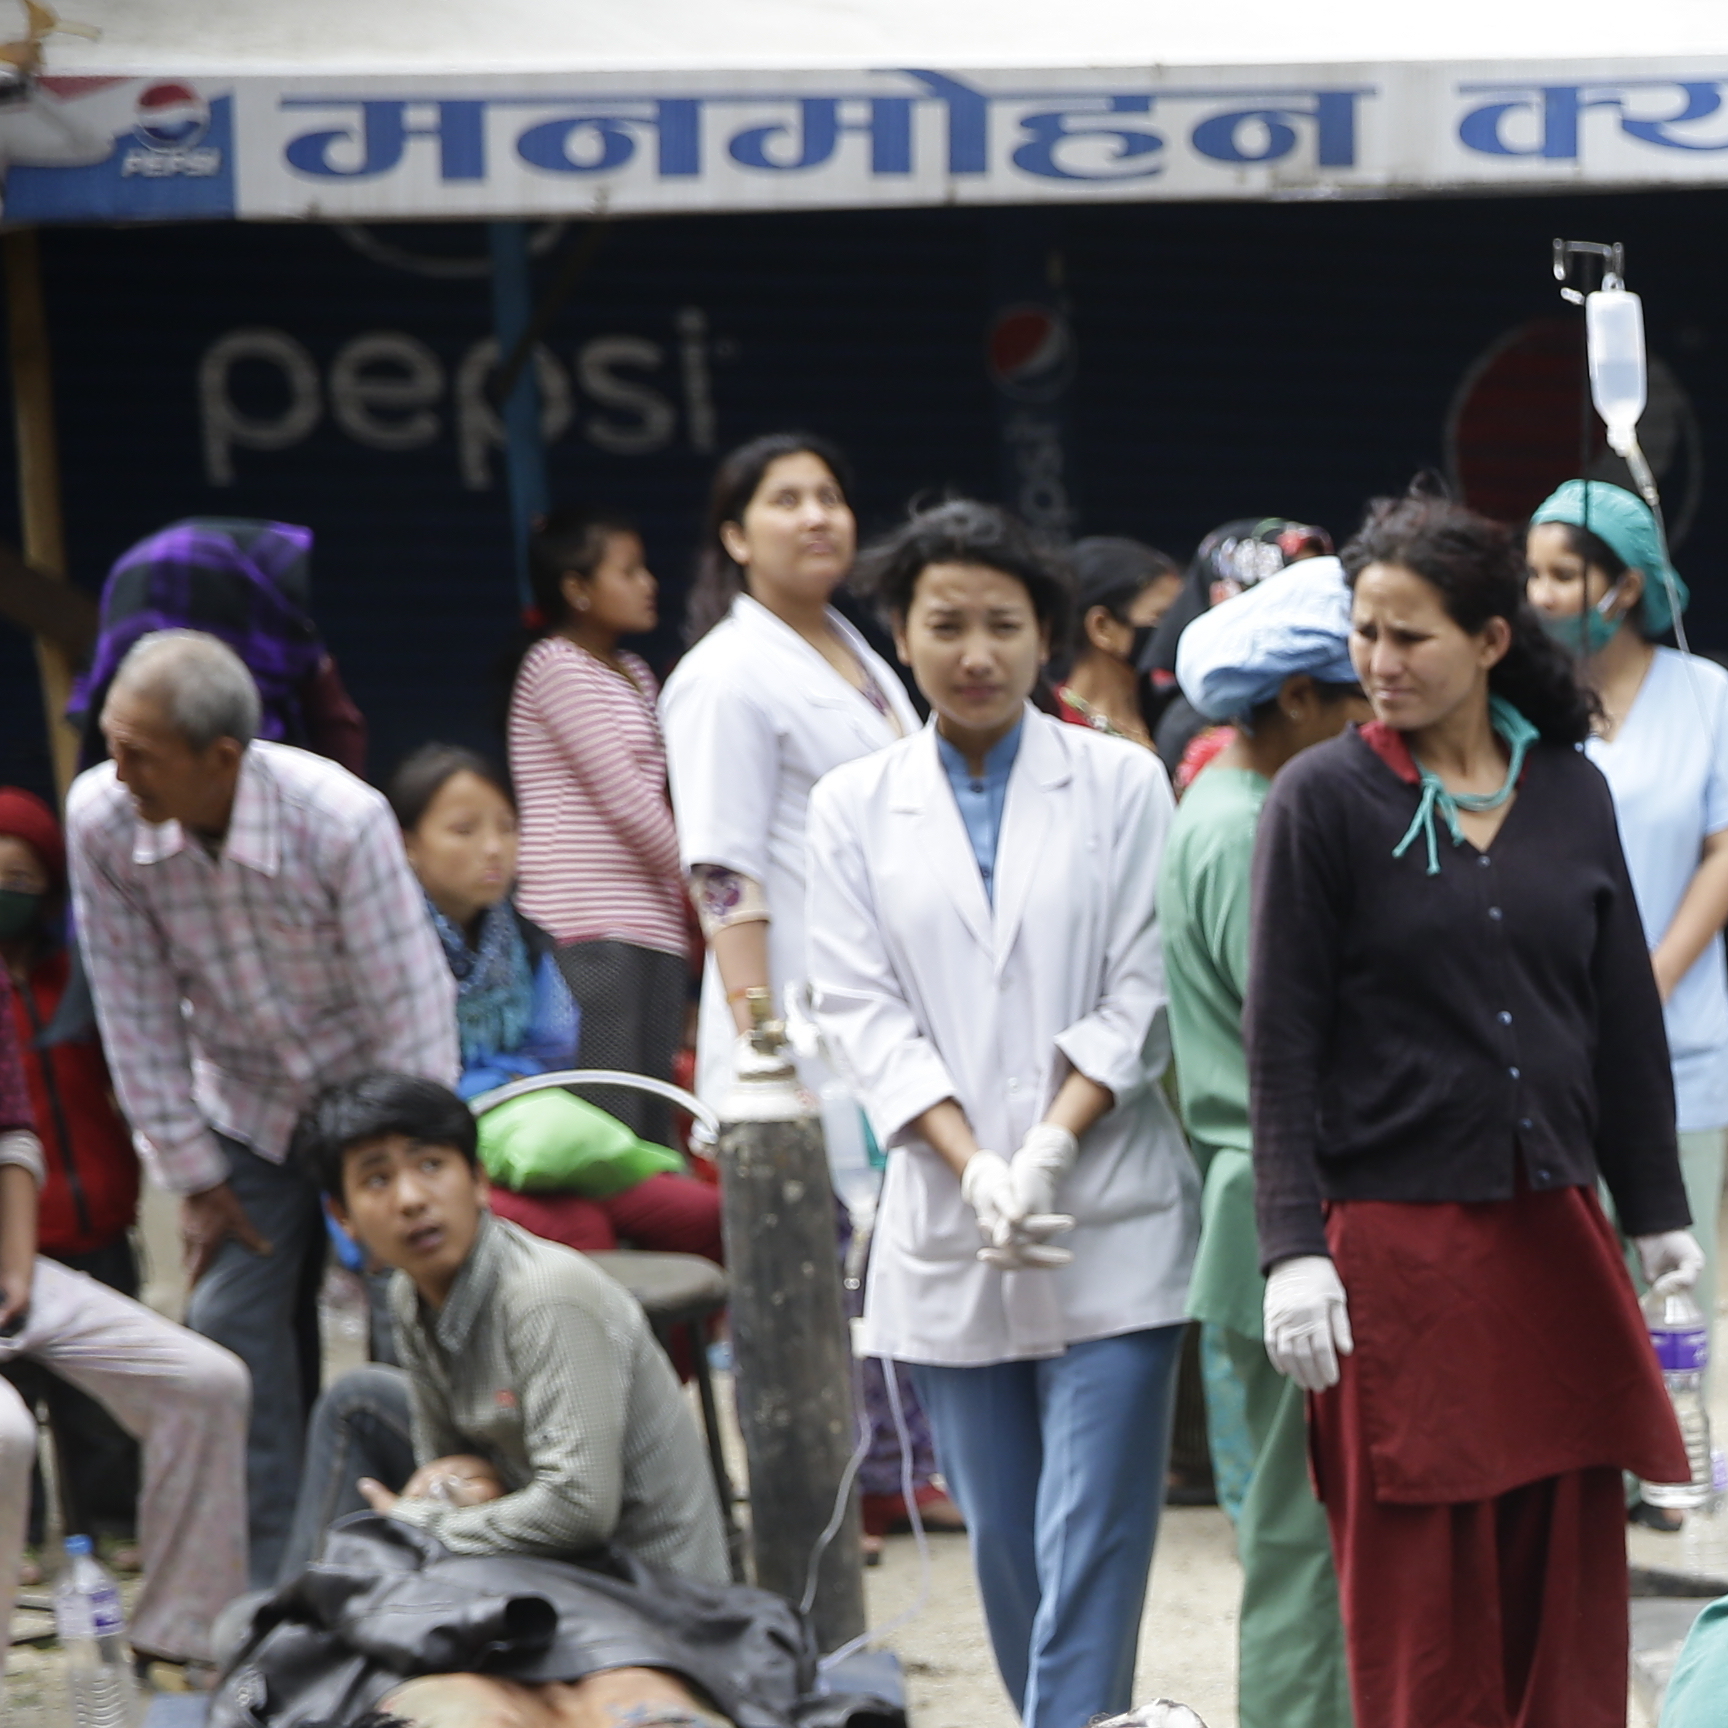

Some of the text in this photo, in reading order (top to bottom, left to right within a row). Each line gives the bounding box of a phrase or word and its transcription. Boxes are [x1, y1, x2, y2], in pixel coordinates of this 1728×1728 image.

[121, 149, 221, 177] PEPSI
[280, 68, 1377, 183] मनमोहन
[198, 306, 719, 490] pepsi
